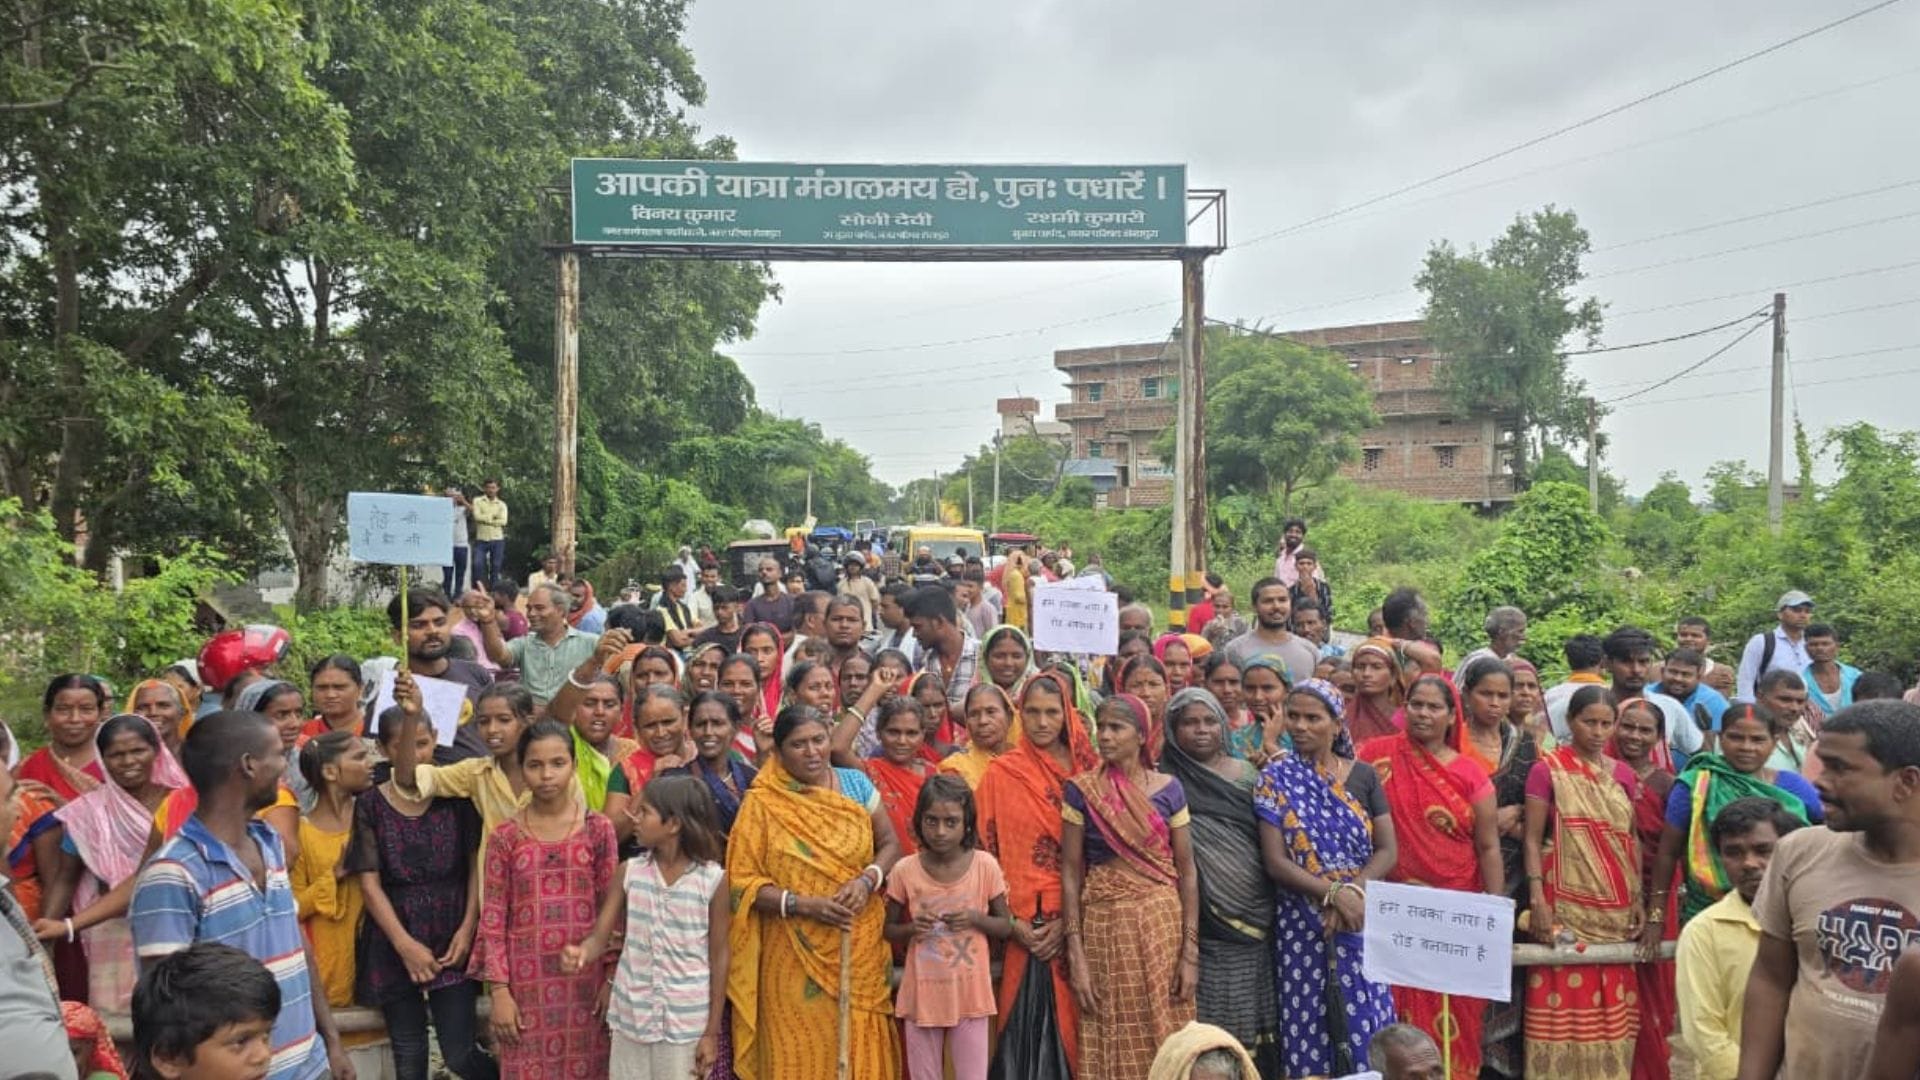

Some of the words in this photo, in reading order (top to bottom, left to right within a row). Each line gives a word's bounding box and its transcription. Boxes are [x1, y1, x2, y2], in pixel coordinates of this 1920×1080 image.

[595, 167, 709, 197] आपकी
[714, 175, 791, 198] यात्रा
[793, 168, 939, 200] मंगलमय
[944, 170, 990, 203] हो,
[993, 177, 1057, 208] पुनः
[1064, 169, 1147, 200] पधारें
[631, 204, 680, 221] विनय
[683, 209, 737, 225] कुमार
[893, 212, 935, 226] देवी
[1083, 209, 1147, 227] कुमारी
[1407, 905, 1445, 921] सबका
[1451, 912, 1481, 927] नारा
[1391, 931, 1413, 947] रोड
[1476, 944, 1488, 962] है
